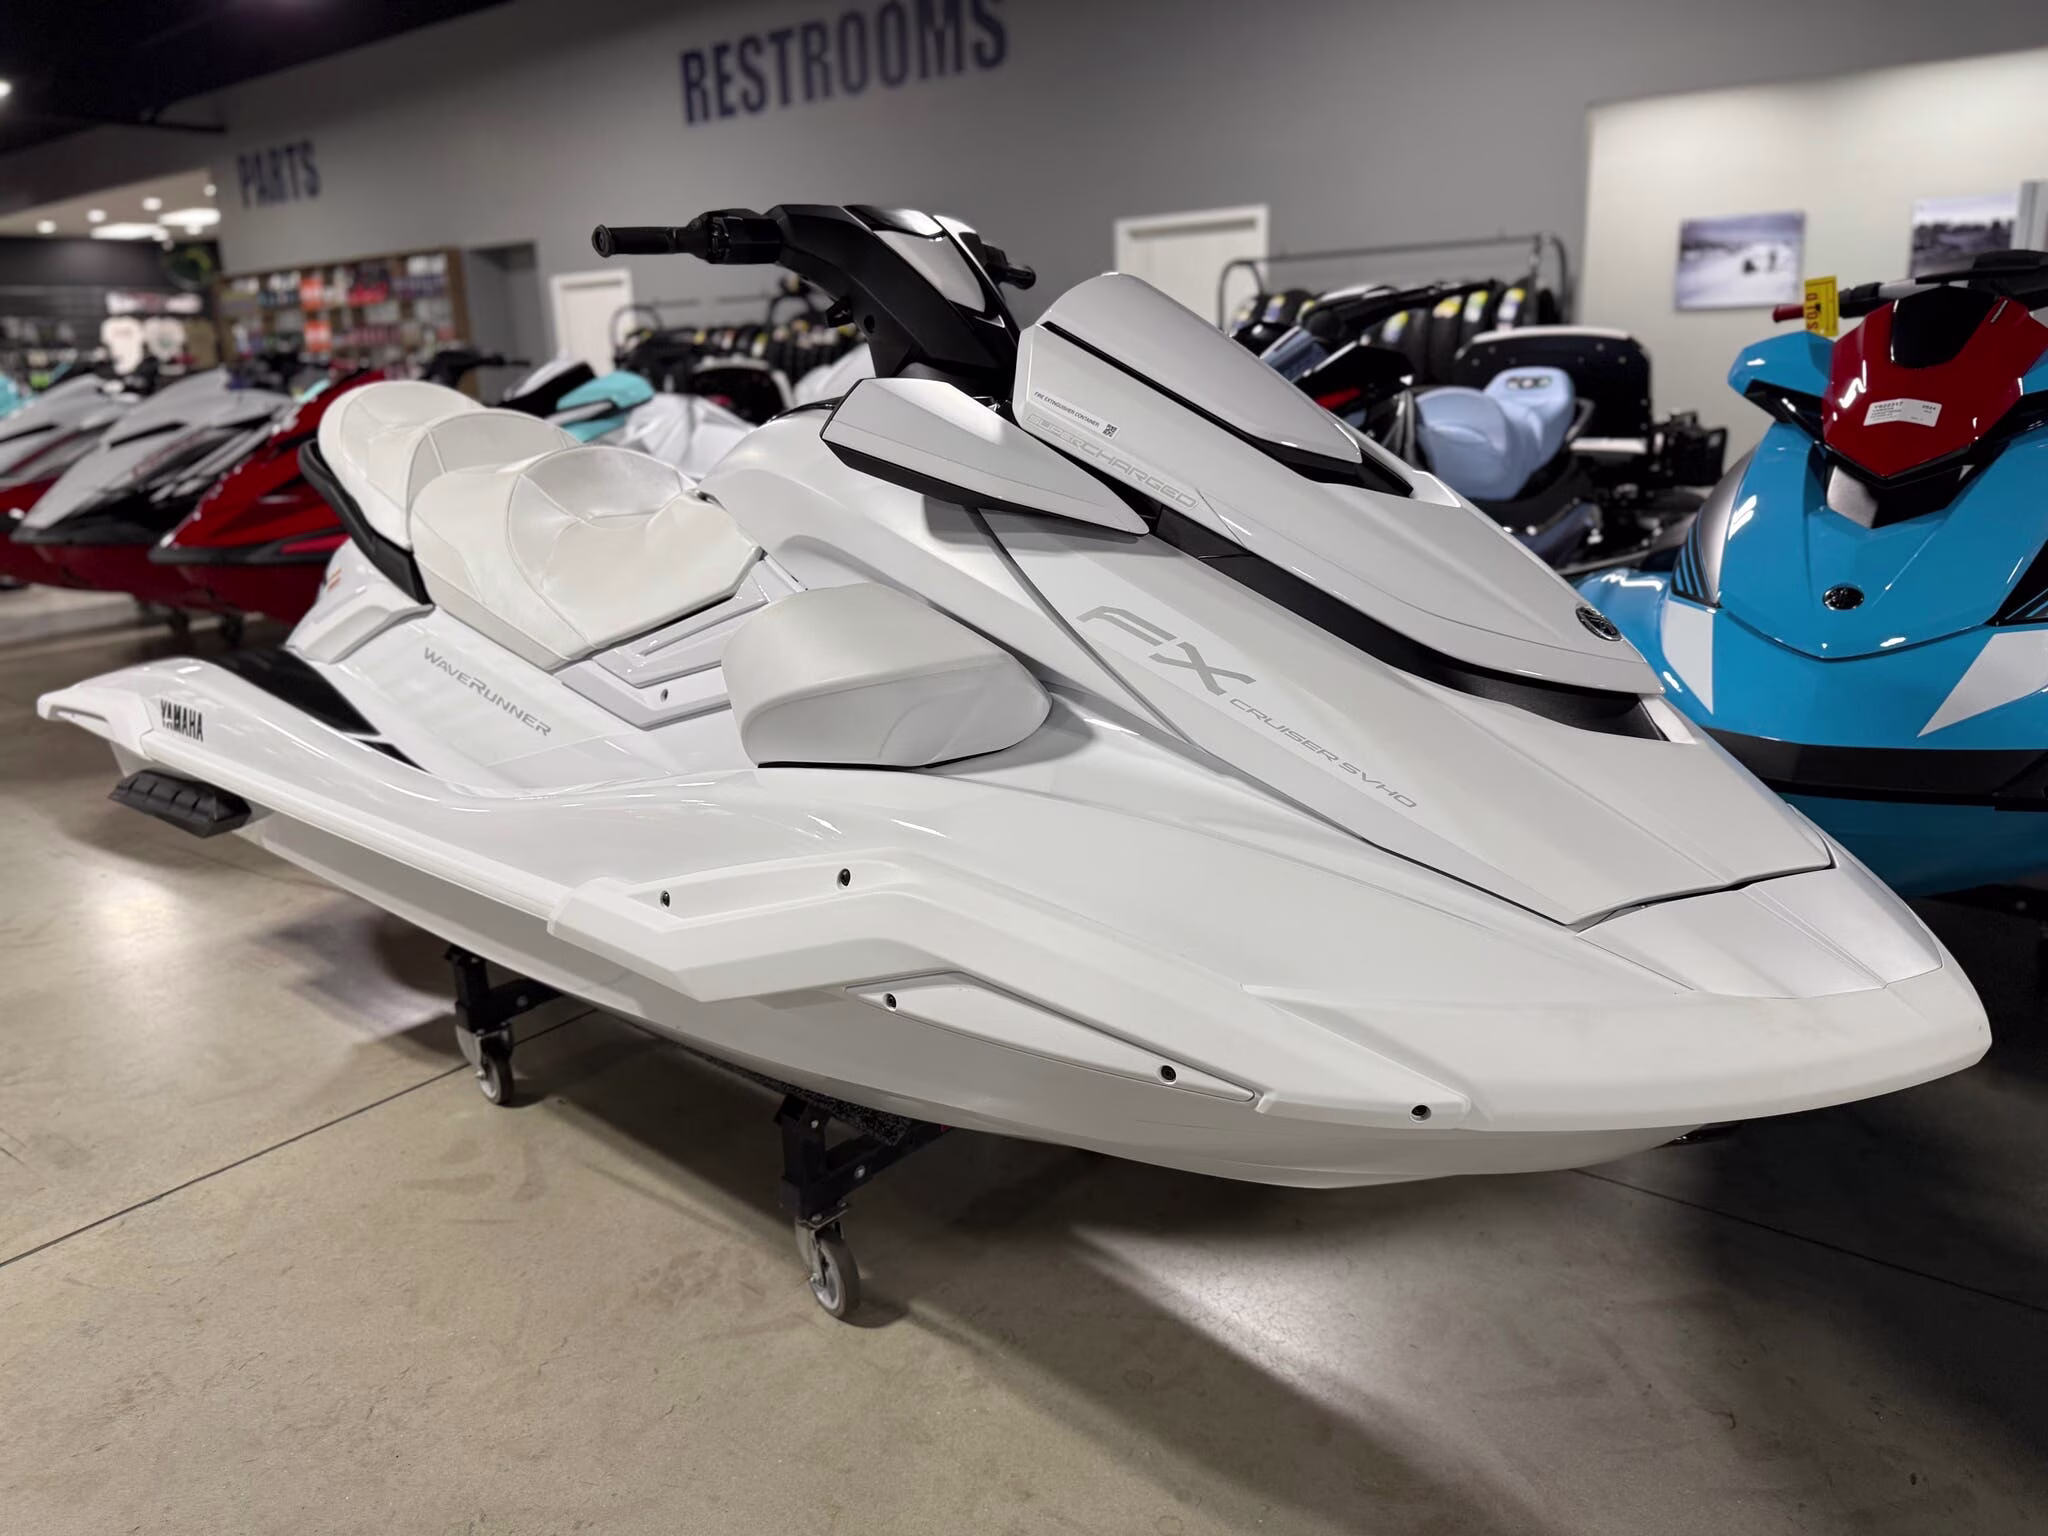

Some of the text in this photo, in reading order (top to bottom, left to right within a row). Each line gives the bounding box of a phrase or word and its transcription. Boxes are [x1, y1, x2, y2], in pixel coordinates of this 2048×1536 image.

[680, 0, 1007, 126] RESTROOMS
[238, 141, 321, 206] PARTS
[1074, 411, 1100, 428] CONTAINER
[1026, 413, 1199, 511] SUPERCHARGED
[160, 698, 204, 742] YAMAHA
[1076, 605, 1417, 808] FX CRUISER SVHO
